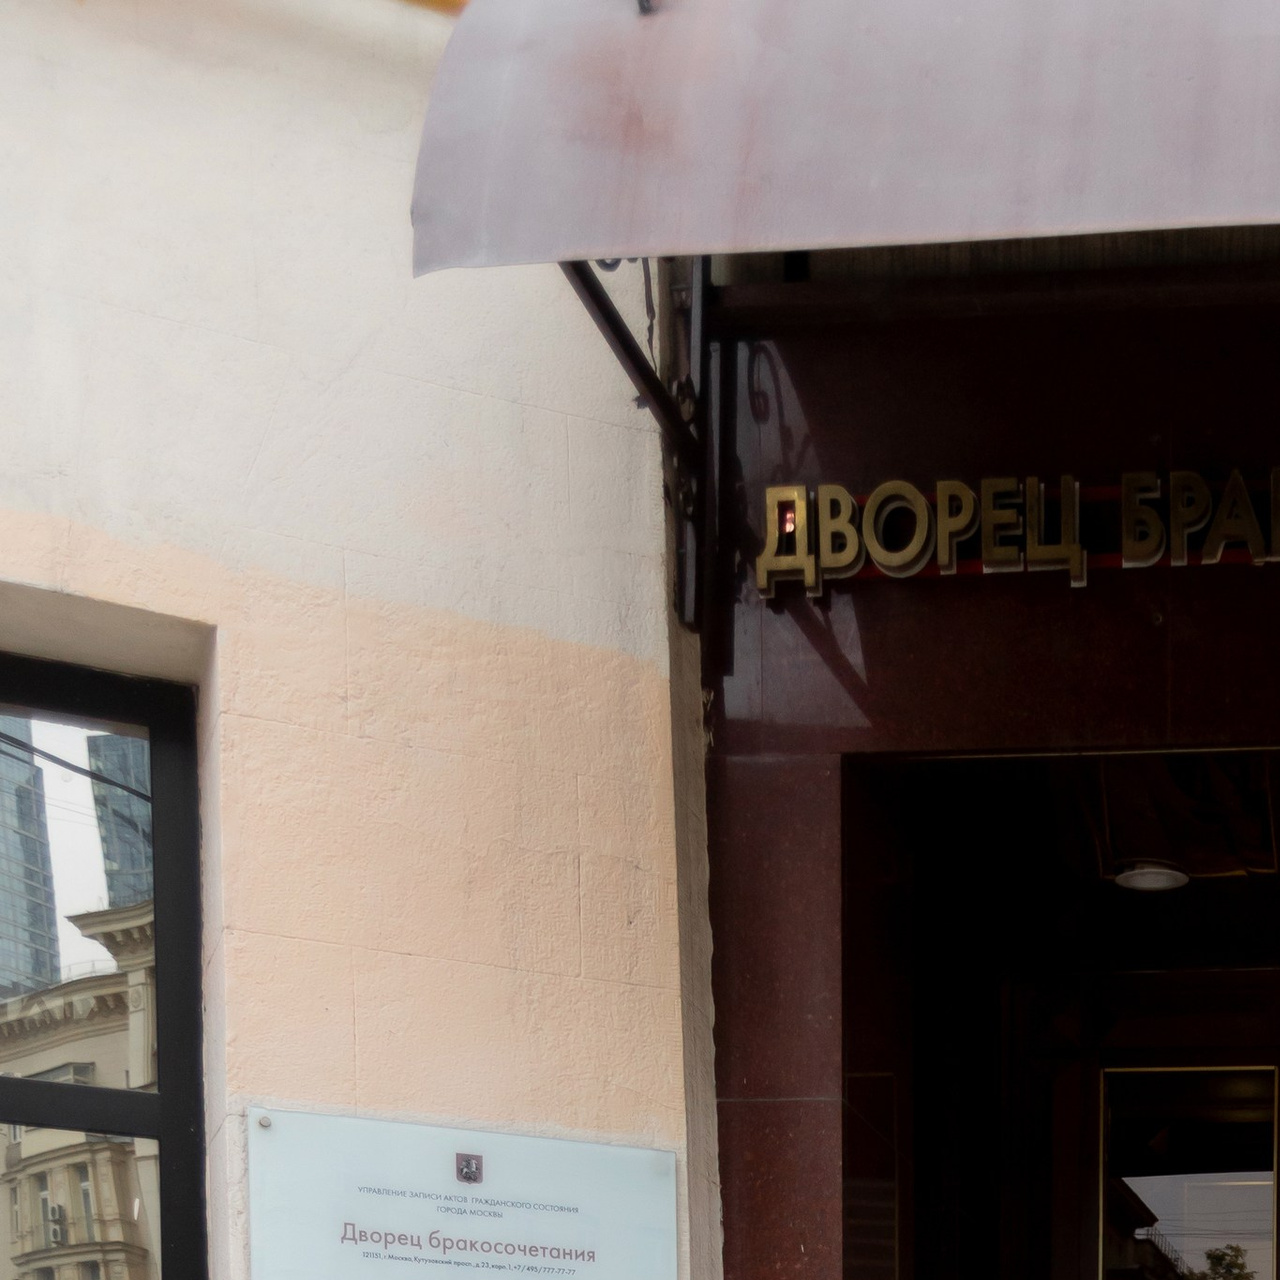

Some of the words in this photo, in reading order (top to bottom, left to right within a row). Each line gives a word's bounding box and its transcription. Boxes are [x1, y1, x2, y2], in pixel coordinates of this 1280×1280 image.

[755, 478, 1087, 599] ДВОРЕЦ
[357, 1186, 407, 1198] УПРАВЛЕНИЕ
[409, 1190, 442, 1201] ЗАПИСИ
[444, 1194, 468, 1204] АКТОВ
[471, 1197, 532, 1210] ГРАЖДАНСКОГО
[533, 1203, 579, 1214] СОСТОЯНИЯ
[436, 1205, 468, 1216] ГОРОДА
[469, 1209, 503, 1219] МОСКВЫ
[341, 1222, 423, 1250] Дворец
[428, 1229, 596, 1263] бракосочетания
